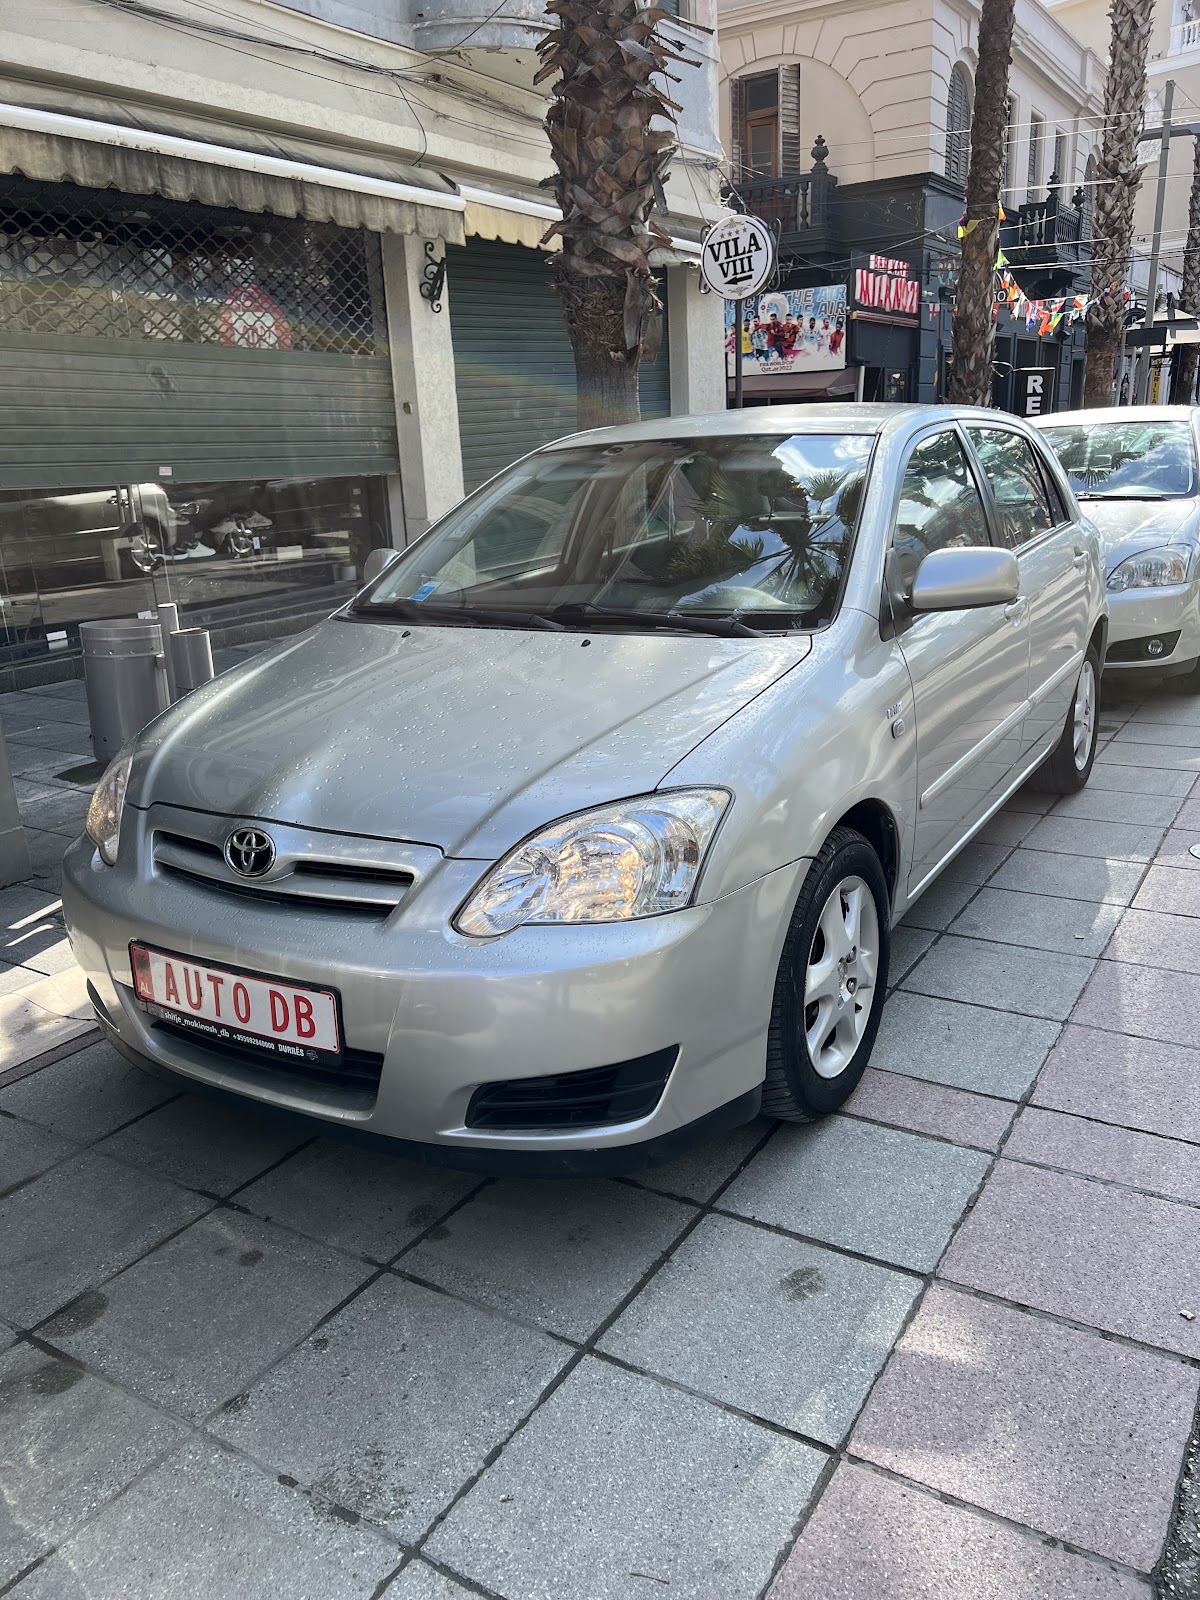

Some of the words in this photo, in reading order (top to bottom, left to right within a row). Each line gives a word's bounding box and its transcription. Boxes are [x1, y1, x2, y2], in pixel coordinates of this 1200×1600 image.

[708, 233, 762, 262] VILA
[718, 255, 754, 278] VIII
[817, 285, 847, 302] AIR
[817, 301, 847, 316] AIR
[140, 981, 152, 995] AL
[165, 962, 251, 1024] AUTO
[269, 989, 316, 1038] DB
[278, 1044, 304, 1057] DURRËS
